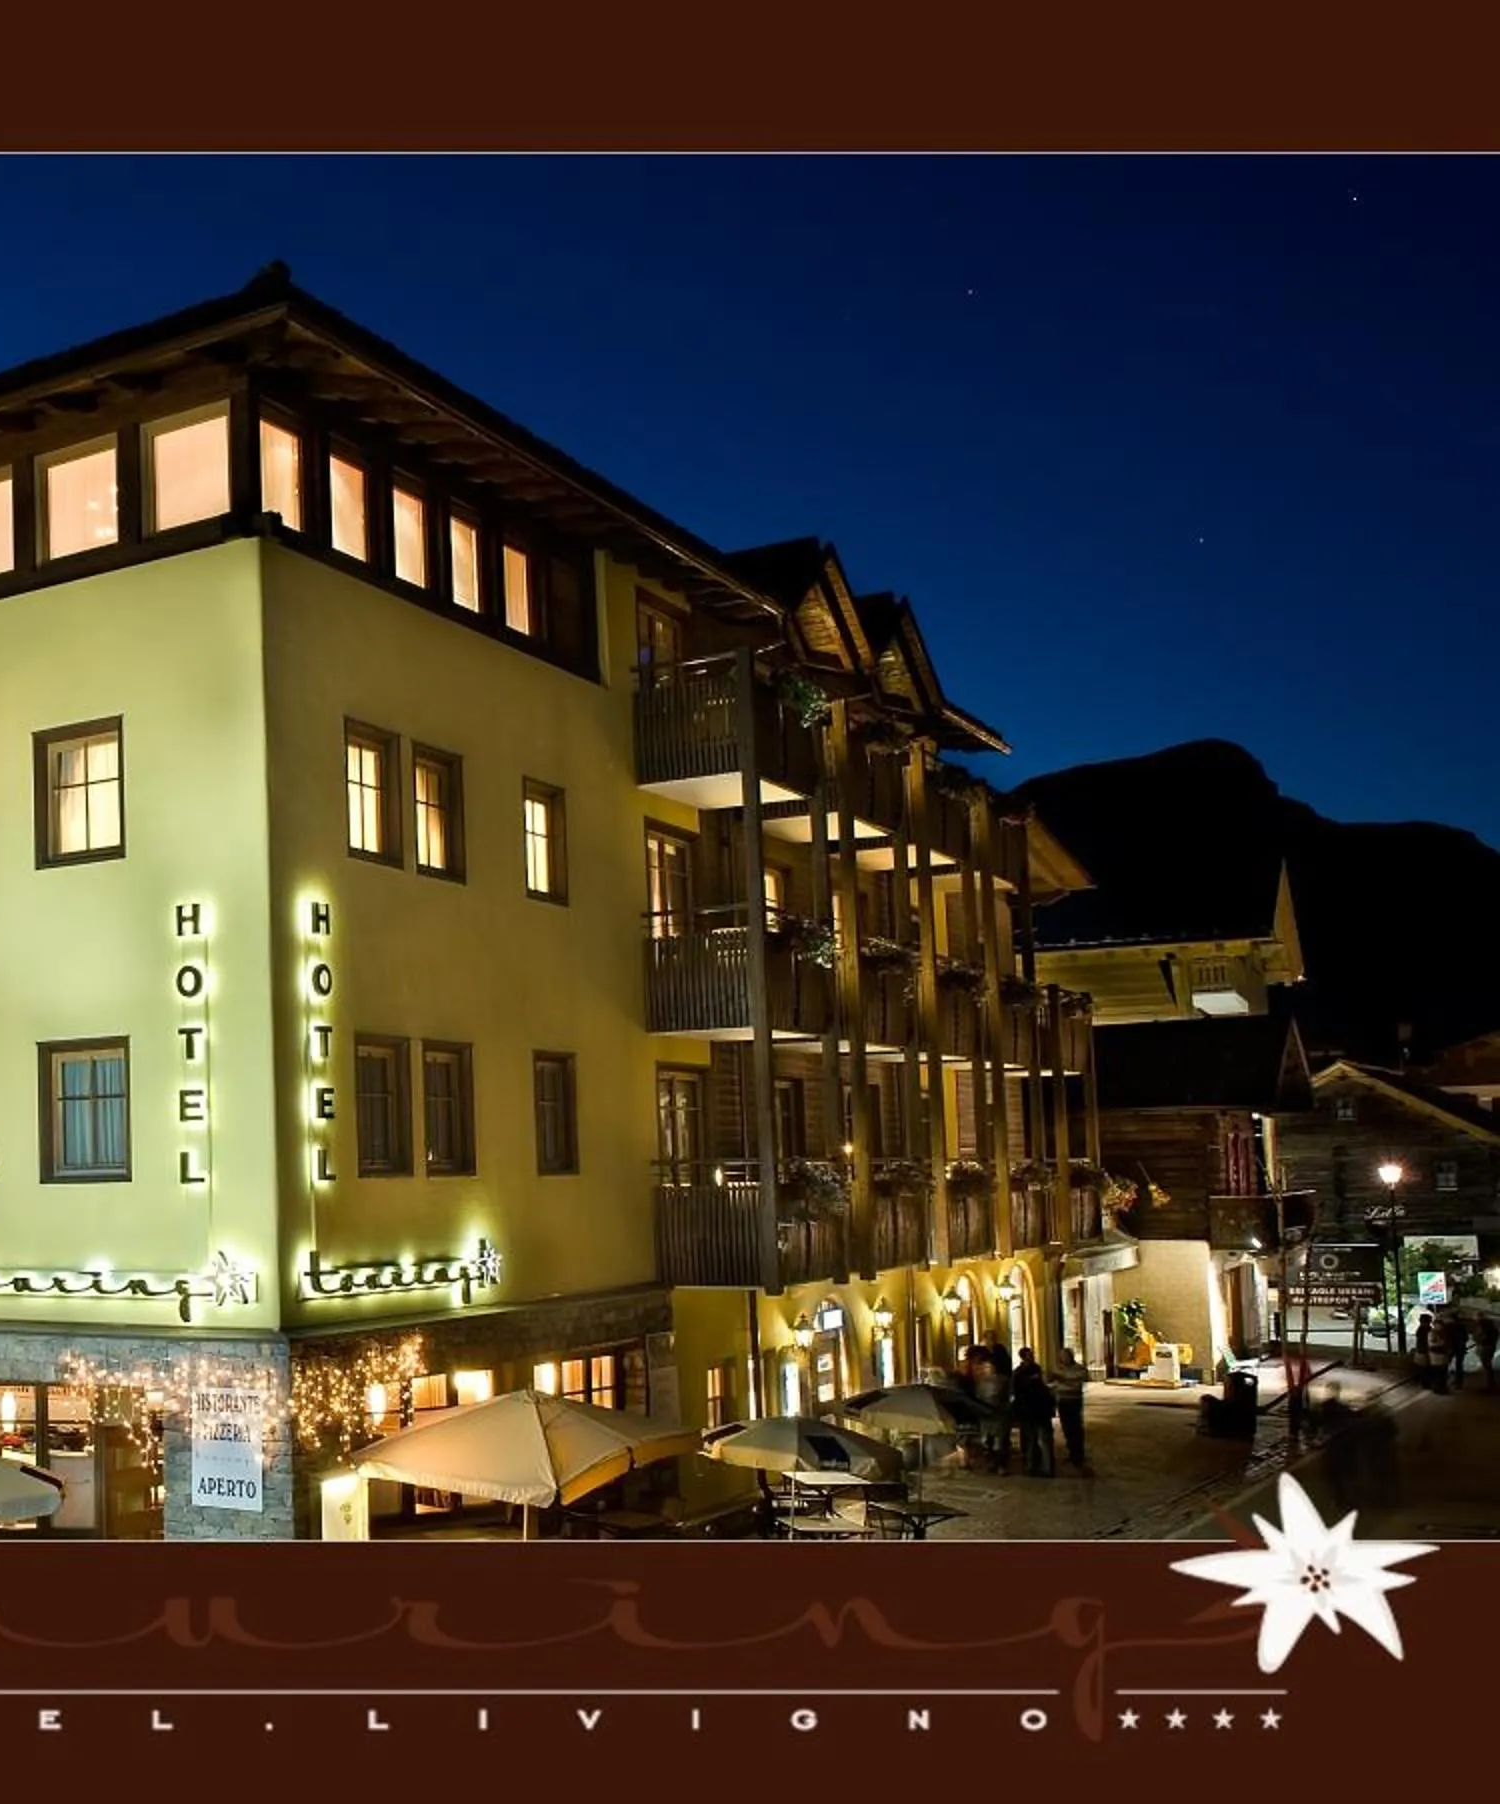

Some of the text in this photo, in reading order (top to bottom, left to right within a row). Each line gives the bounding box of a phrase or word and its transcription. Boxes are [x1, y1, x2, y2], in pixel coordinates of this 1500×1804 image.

[175, 903, 205, 1185] HOTEL
[310, 901, 336, 1181] HOTEL
[197, 1477, 257, 1499] APERTO
